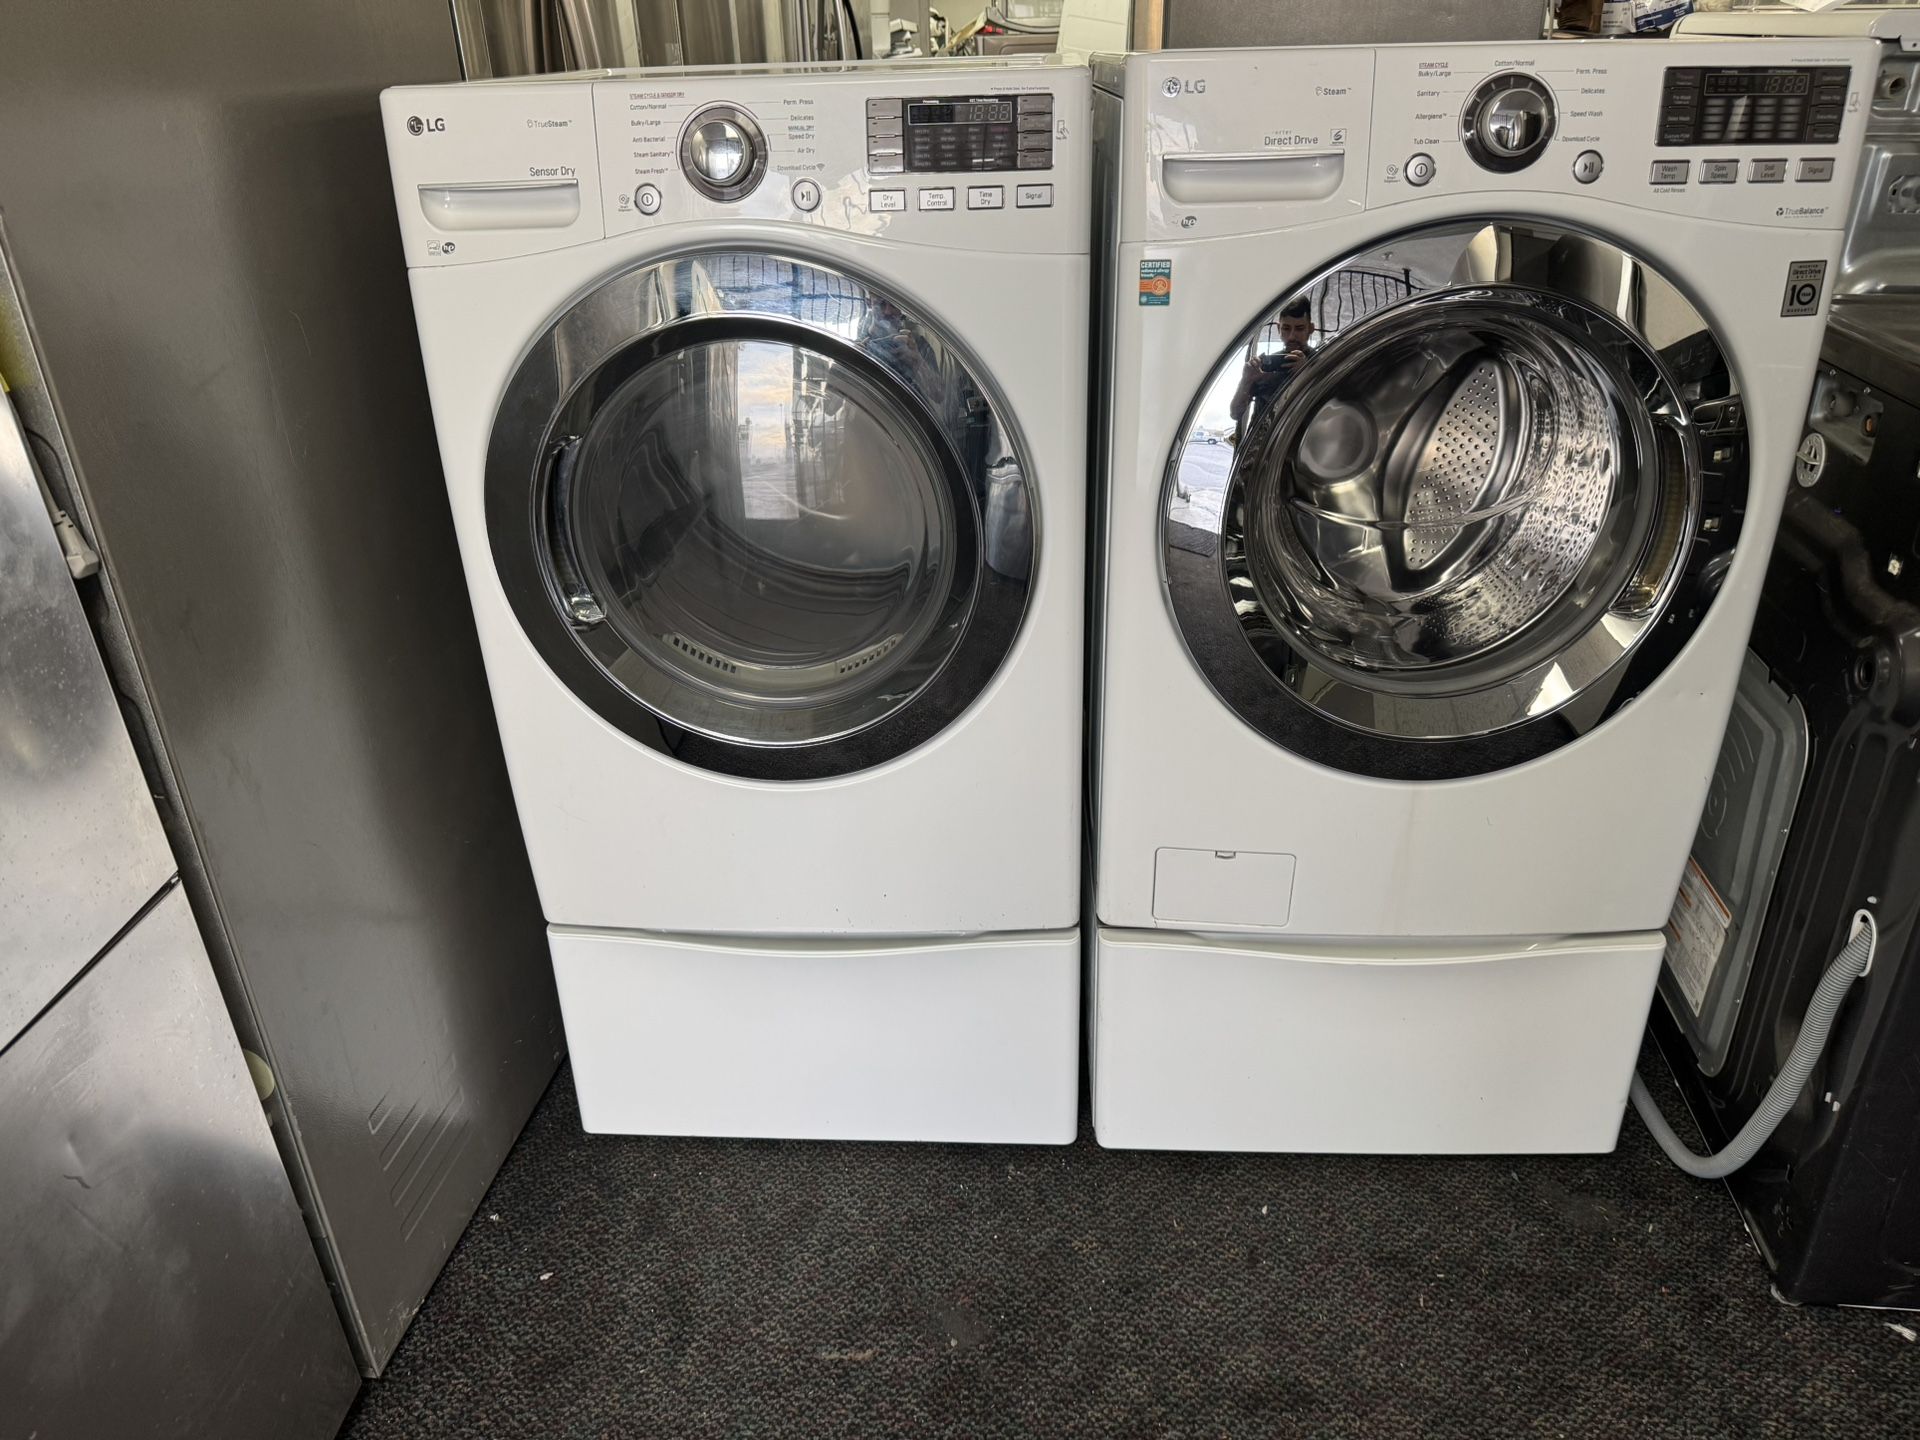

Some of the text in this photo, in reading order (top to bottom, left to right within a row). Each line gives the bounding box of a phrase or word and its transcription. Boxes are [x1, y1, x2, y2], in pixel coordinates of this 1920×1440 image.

[1185, 80, 1206, 94] LG
[426, 118, 445, 132] LG
[1264, 135, 1318, 146] Direct Drive
[529, 166, 576, 177] Sensor Dry
[1025, 192, 1043, 200] Signal
[1789, 283, 1816, 306] 10
